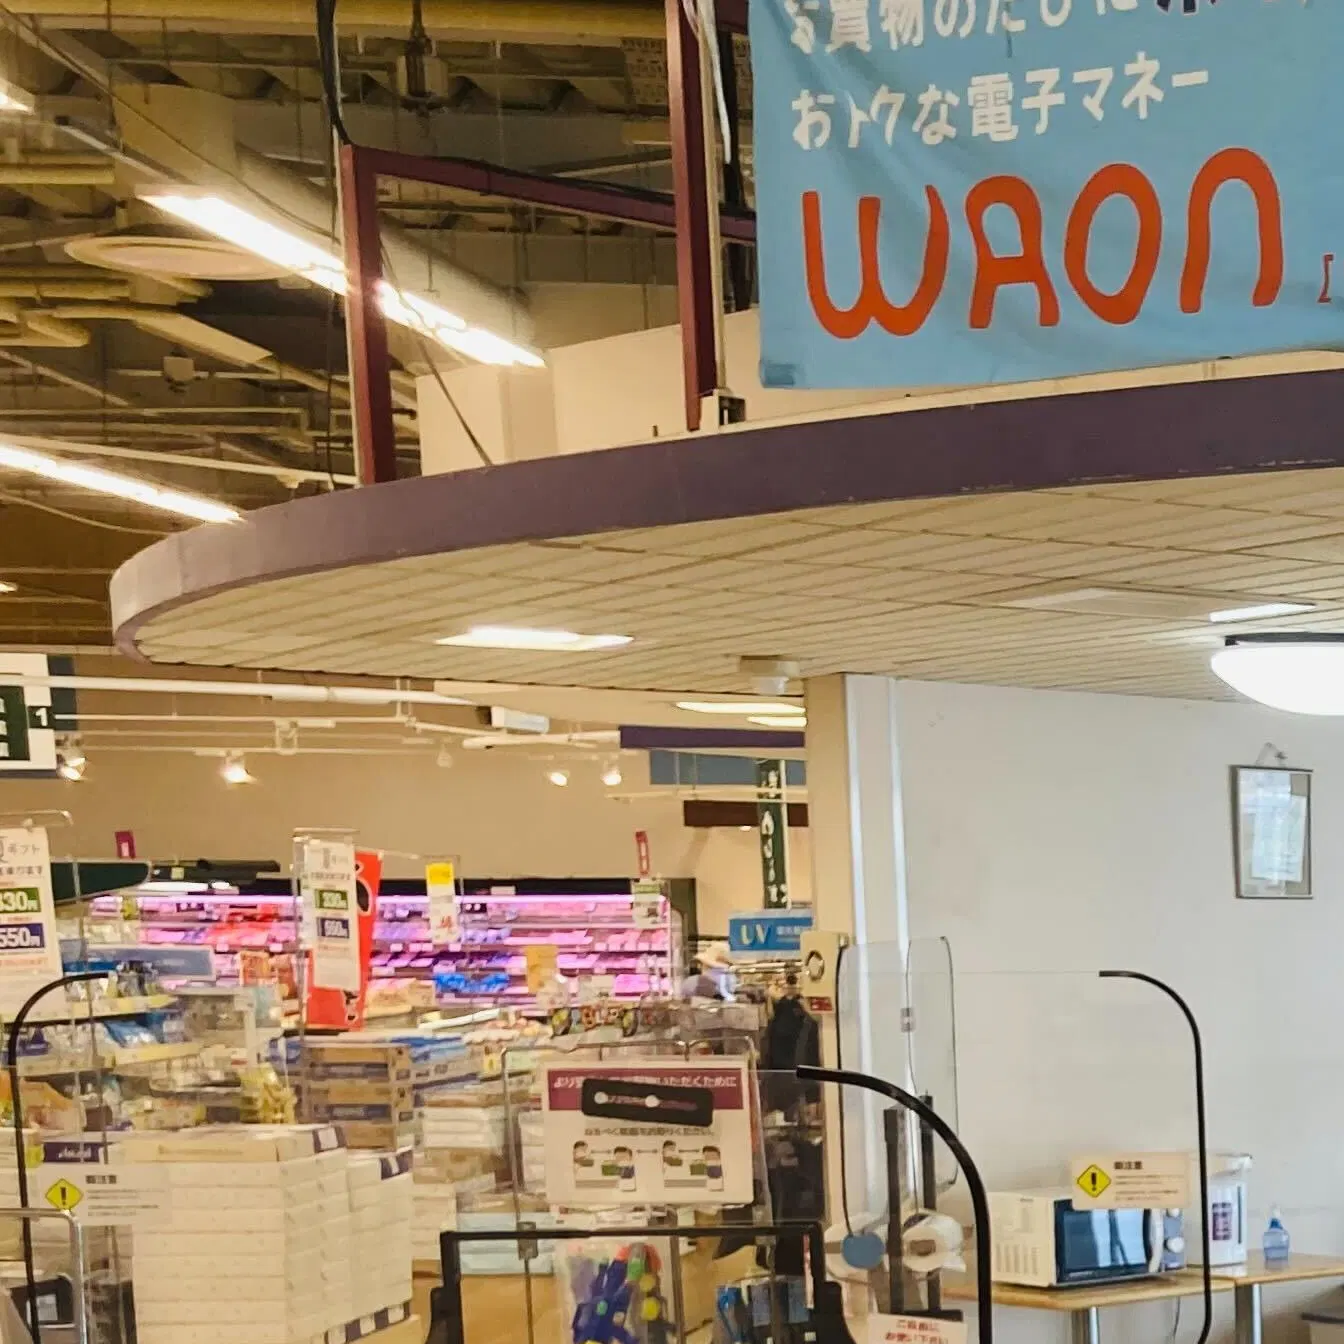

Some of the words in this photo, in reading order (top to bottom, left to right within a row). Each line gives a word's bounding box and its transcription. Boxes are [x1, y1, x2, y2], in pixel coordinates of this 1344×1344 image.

[790, 51, 1210, 150] おトクな電子マネー
[802, 146, 1284, 339] WAON
[34, 707, 48, 726] 1
[0, 891, 38, 911] 30円
[740, 924, 772, 945] UV
